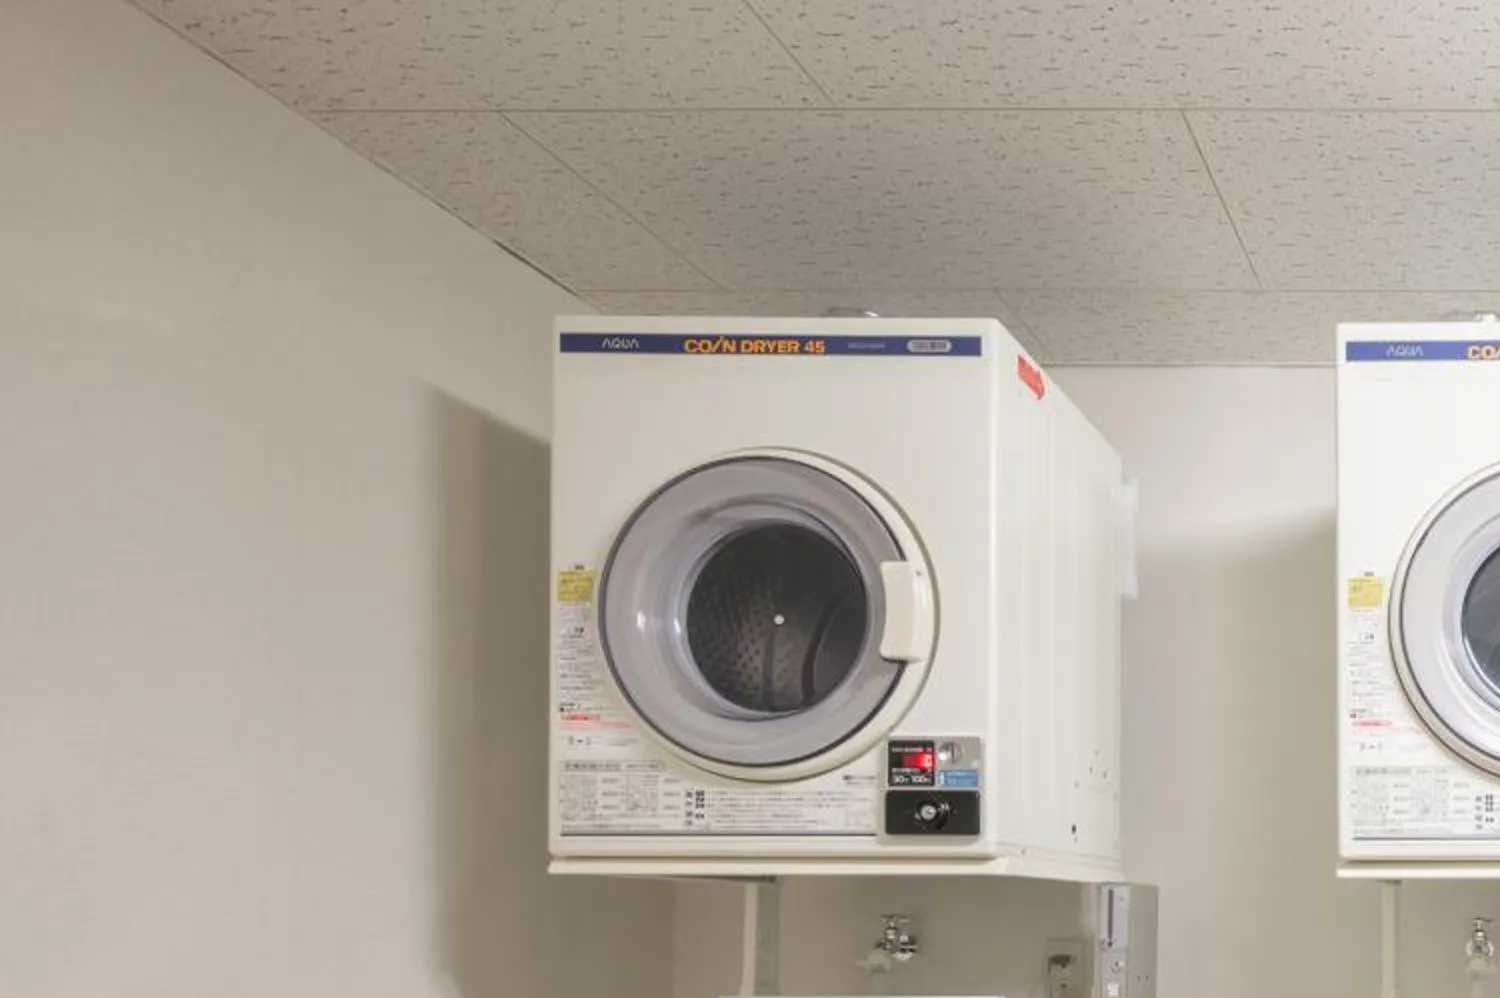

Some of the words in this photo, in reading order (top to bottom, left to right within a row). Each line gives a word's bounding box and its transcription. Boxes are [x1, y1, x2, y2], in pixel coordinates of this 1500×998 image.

[602, 337, 639, 349] AQUA
[741, 340, 800, 354] DRYER
[804, 341, 825, 354] 45
